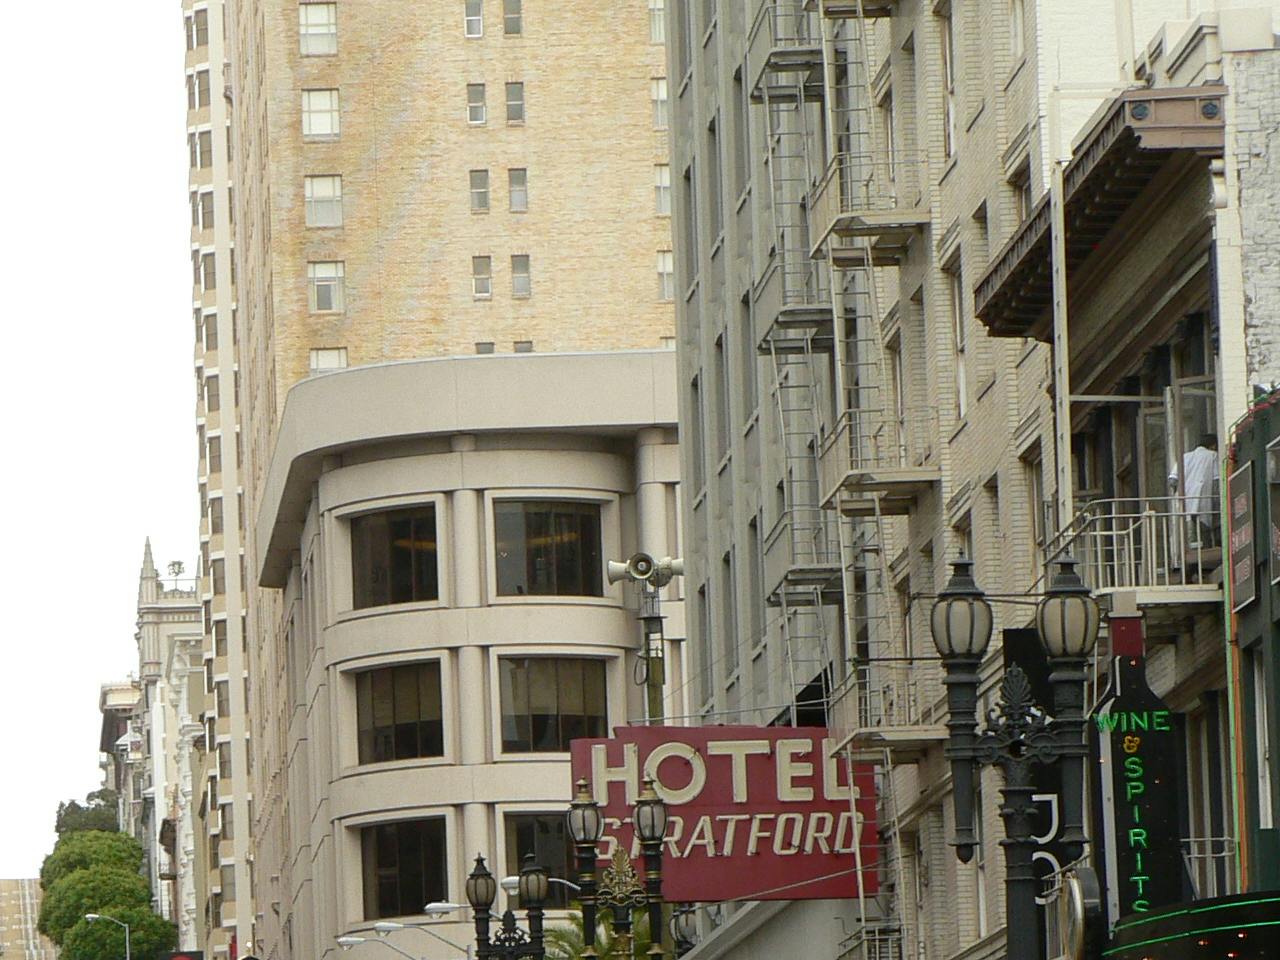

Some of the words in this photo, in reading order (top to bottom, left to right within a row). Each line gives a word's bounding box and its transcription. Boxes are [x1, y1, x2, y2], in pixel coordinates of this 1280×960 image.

[1095, 711, 1170, 731] WINE
[1123, 736, 1139, 753] &
[591, 738, 861, 806] HOTEL
[595, 812, 865, 861] STRATFORD
[1123, 757, 1150, 912] SPIRITS
